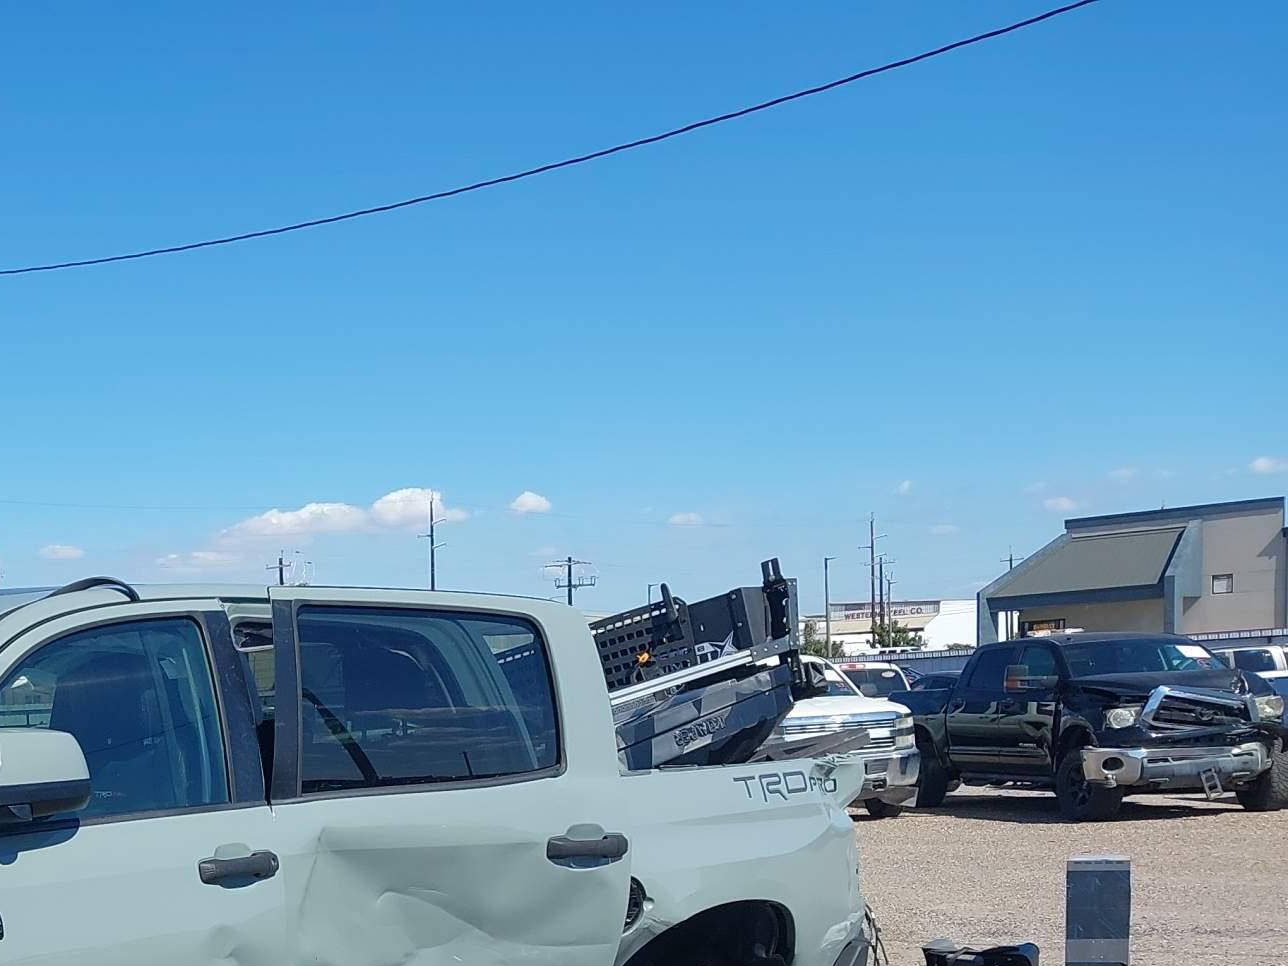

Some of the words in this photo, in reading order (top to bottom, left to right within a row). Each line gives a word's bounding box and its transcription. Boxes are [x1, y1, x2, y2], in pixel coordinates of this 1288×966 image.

[844, 610, 884, 620] WESTE
[733, 770, 808, 803] TRD
[808, 776, 837, 794] PRO
